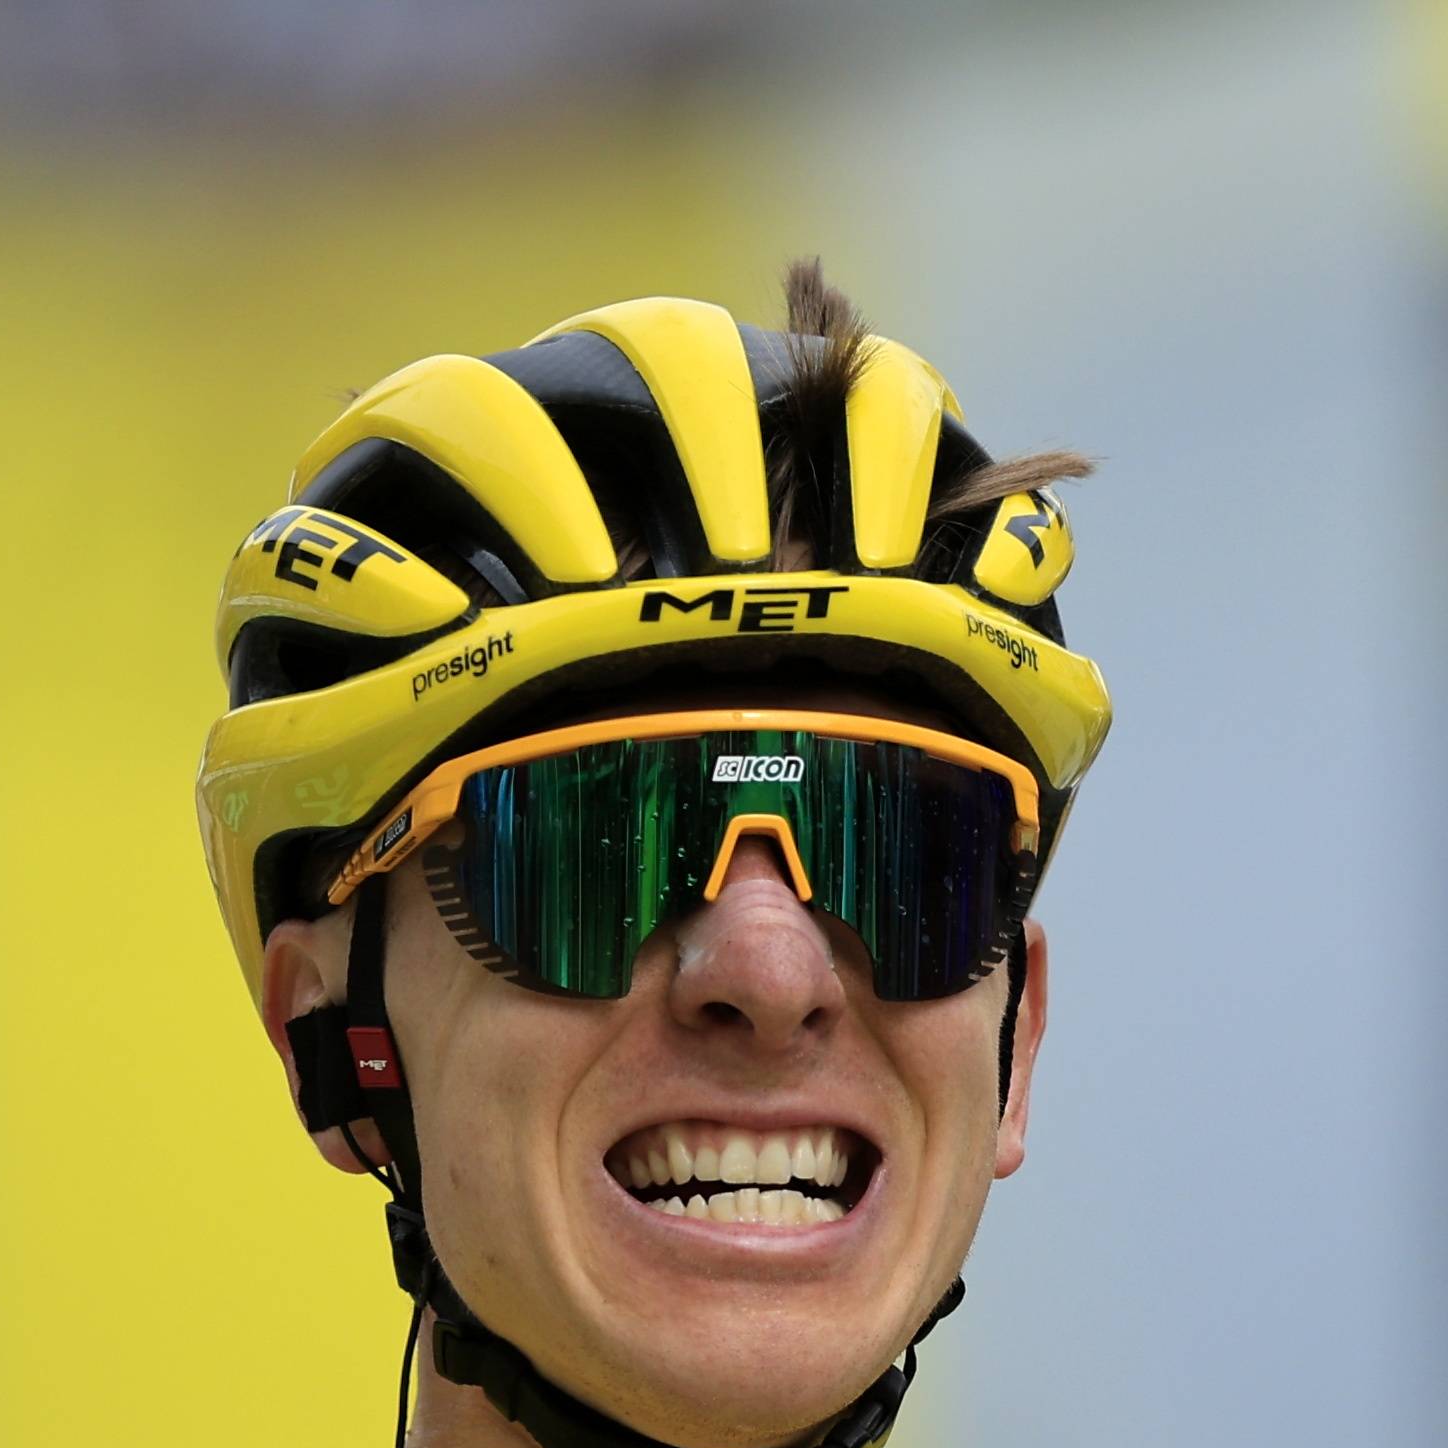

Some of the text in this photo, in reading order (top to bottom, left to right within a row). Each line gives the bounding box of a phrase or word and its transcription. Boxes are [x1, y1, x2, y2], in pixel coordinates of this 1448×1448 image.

[639, 586, 849, 632] MET
[412, 631, 514, 701] presight
[966, 613, 1039, 672] presight
[359, 1060, 388, 1071] MET
